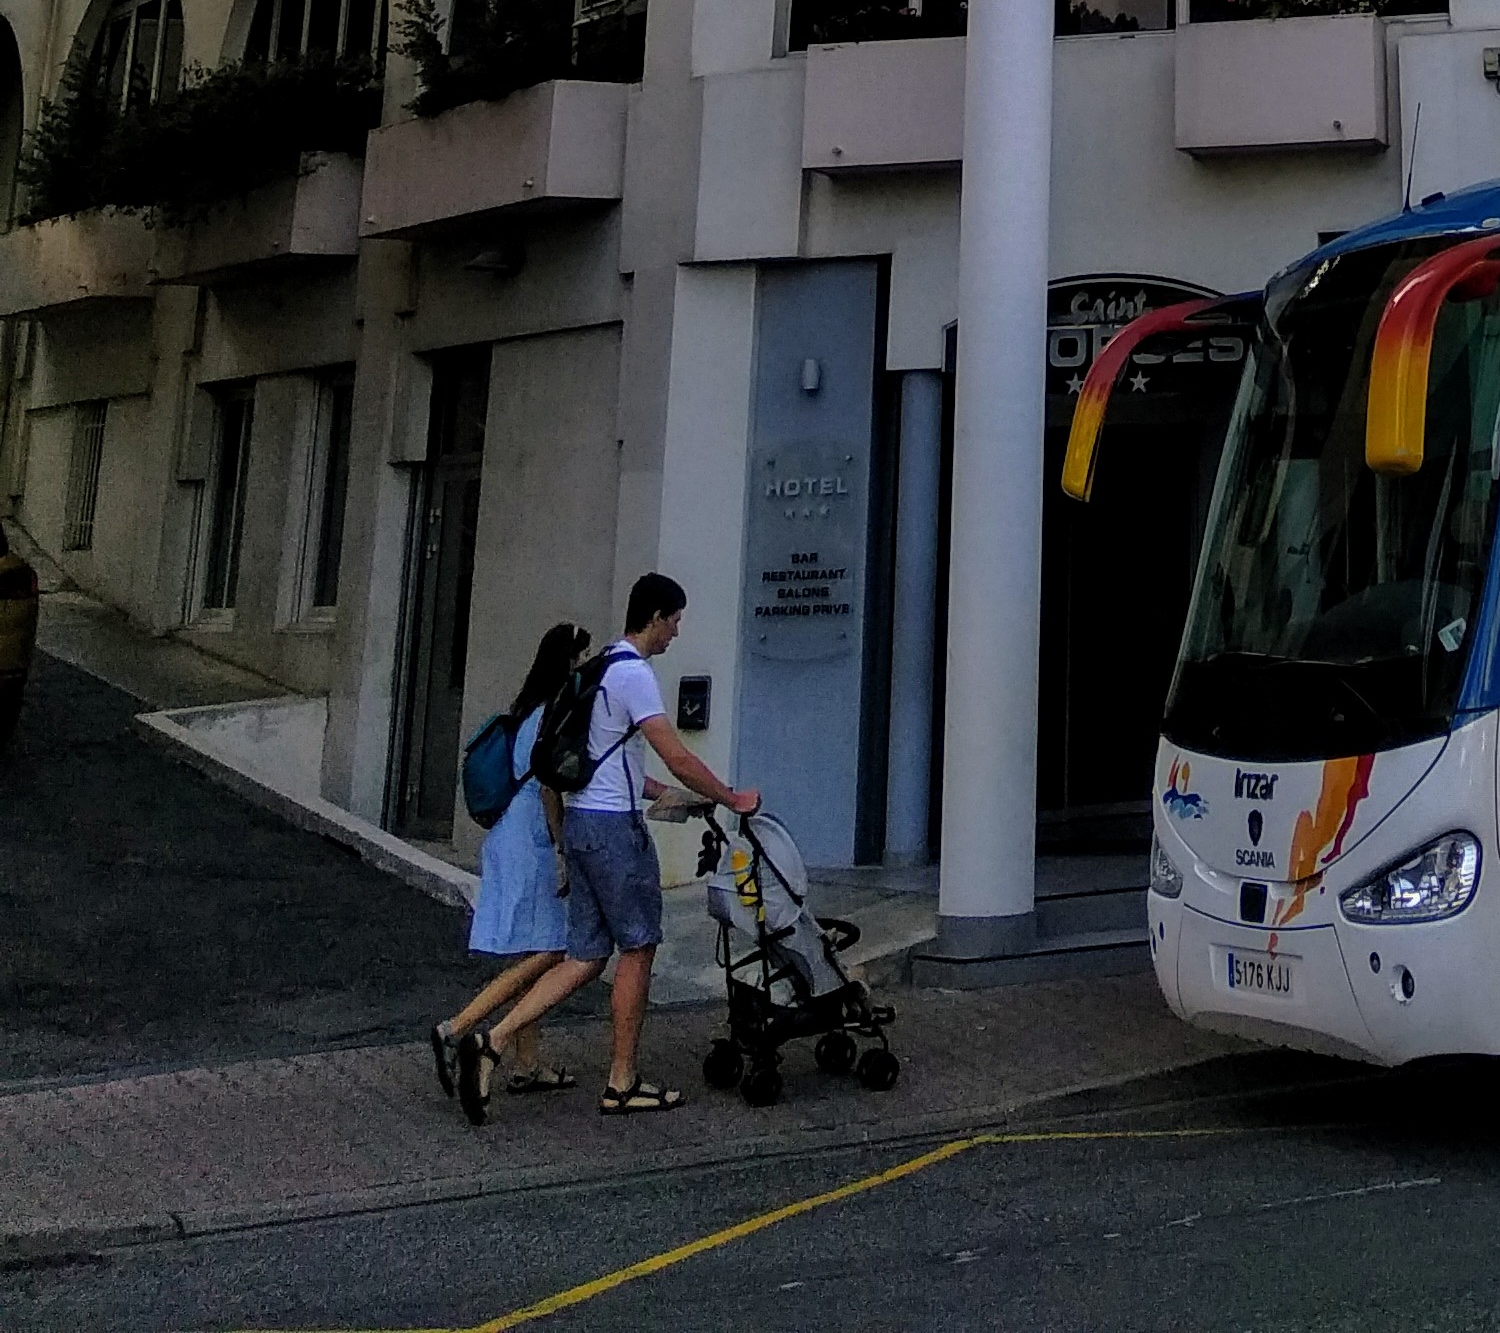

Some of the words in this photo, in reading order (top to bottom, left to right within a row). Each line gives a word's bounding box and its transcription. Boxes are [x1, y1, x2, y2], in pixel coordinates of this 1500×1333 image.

[765, 476, 848, 497] HOTEL
[791, 553, 818, 564] BAR
[762, 568, 847, 583] RESTAURANT
[777, 586, 830, 599] SALONS
[755, 605, 810, 617] PARKING
[1235, 848, 1275, 868] SCANIA
[1235, 959, 1264, 989] 5176
[1266, 964, 1290, 993] KJJ
